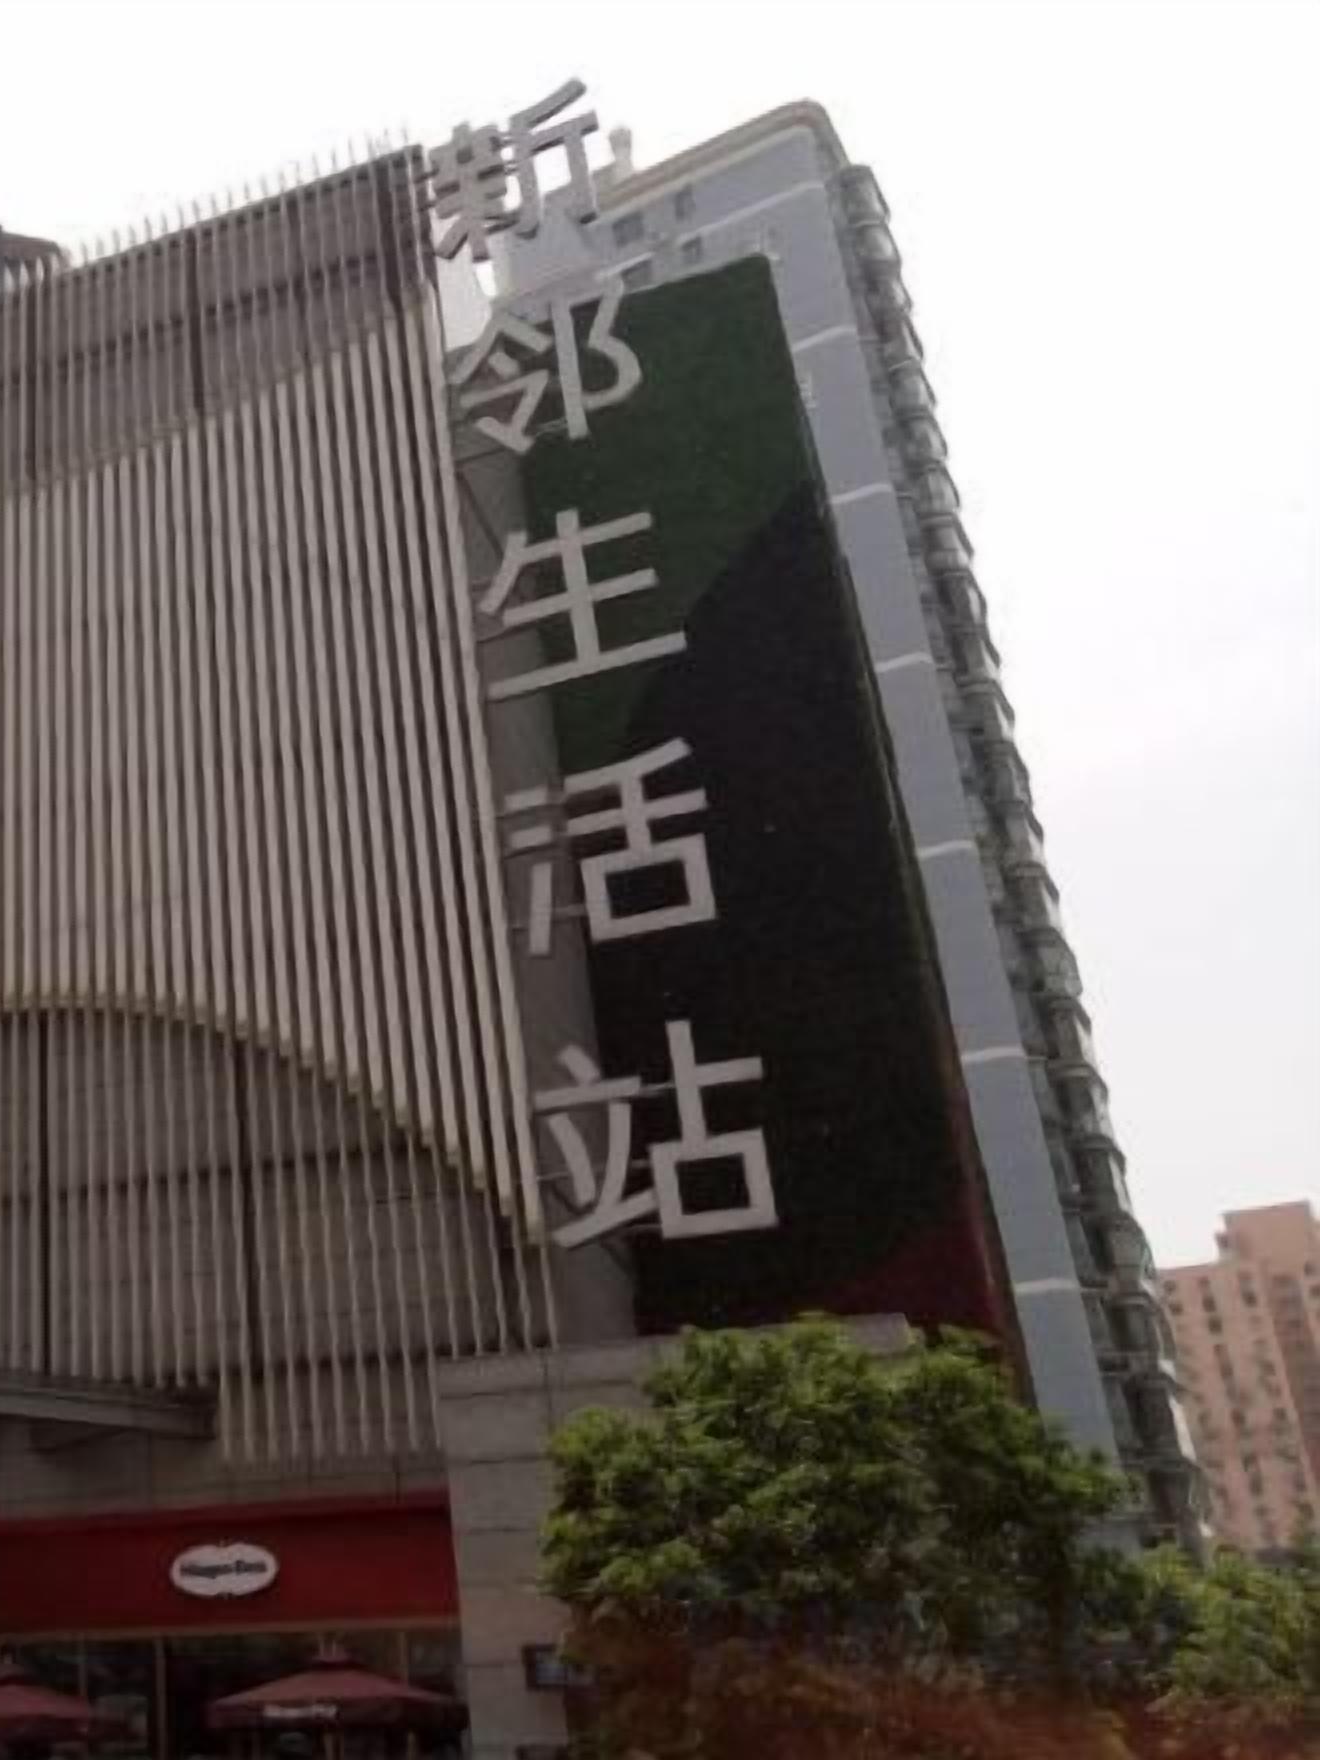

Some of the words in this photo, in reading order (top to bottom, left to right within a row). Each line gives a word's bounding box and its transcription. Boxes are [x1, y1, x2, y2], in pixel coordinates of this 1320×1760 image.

[428, 77, 778, 1248] 新邻生活站
